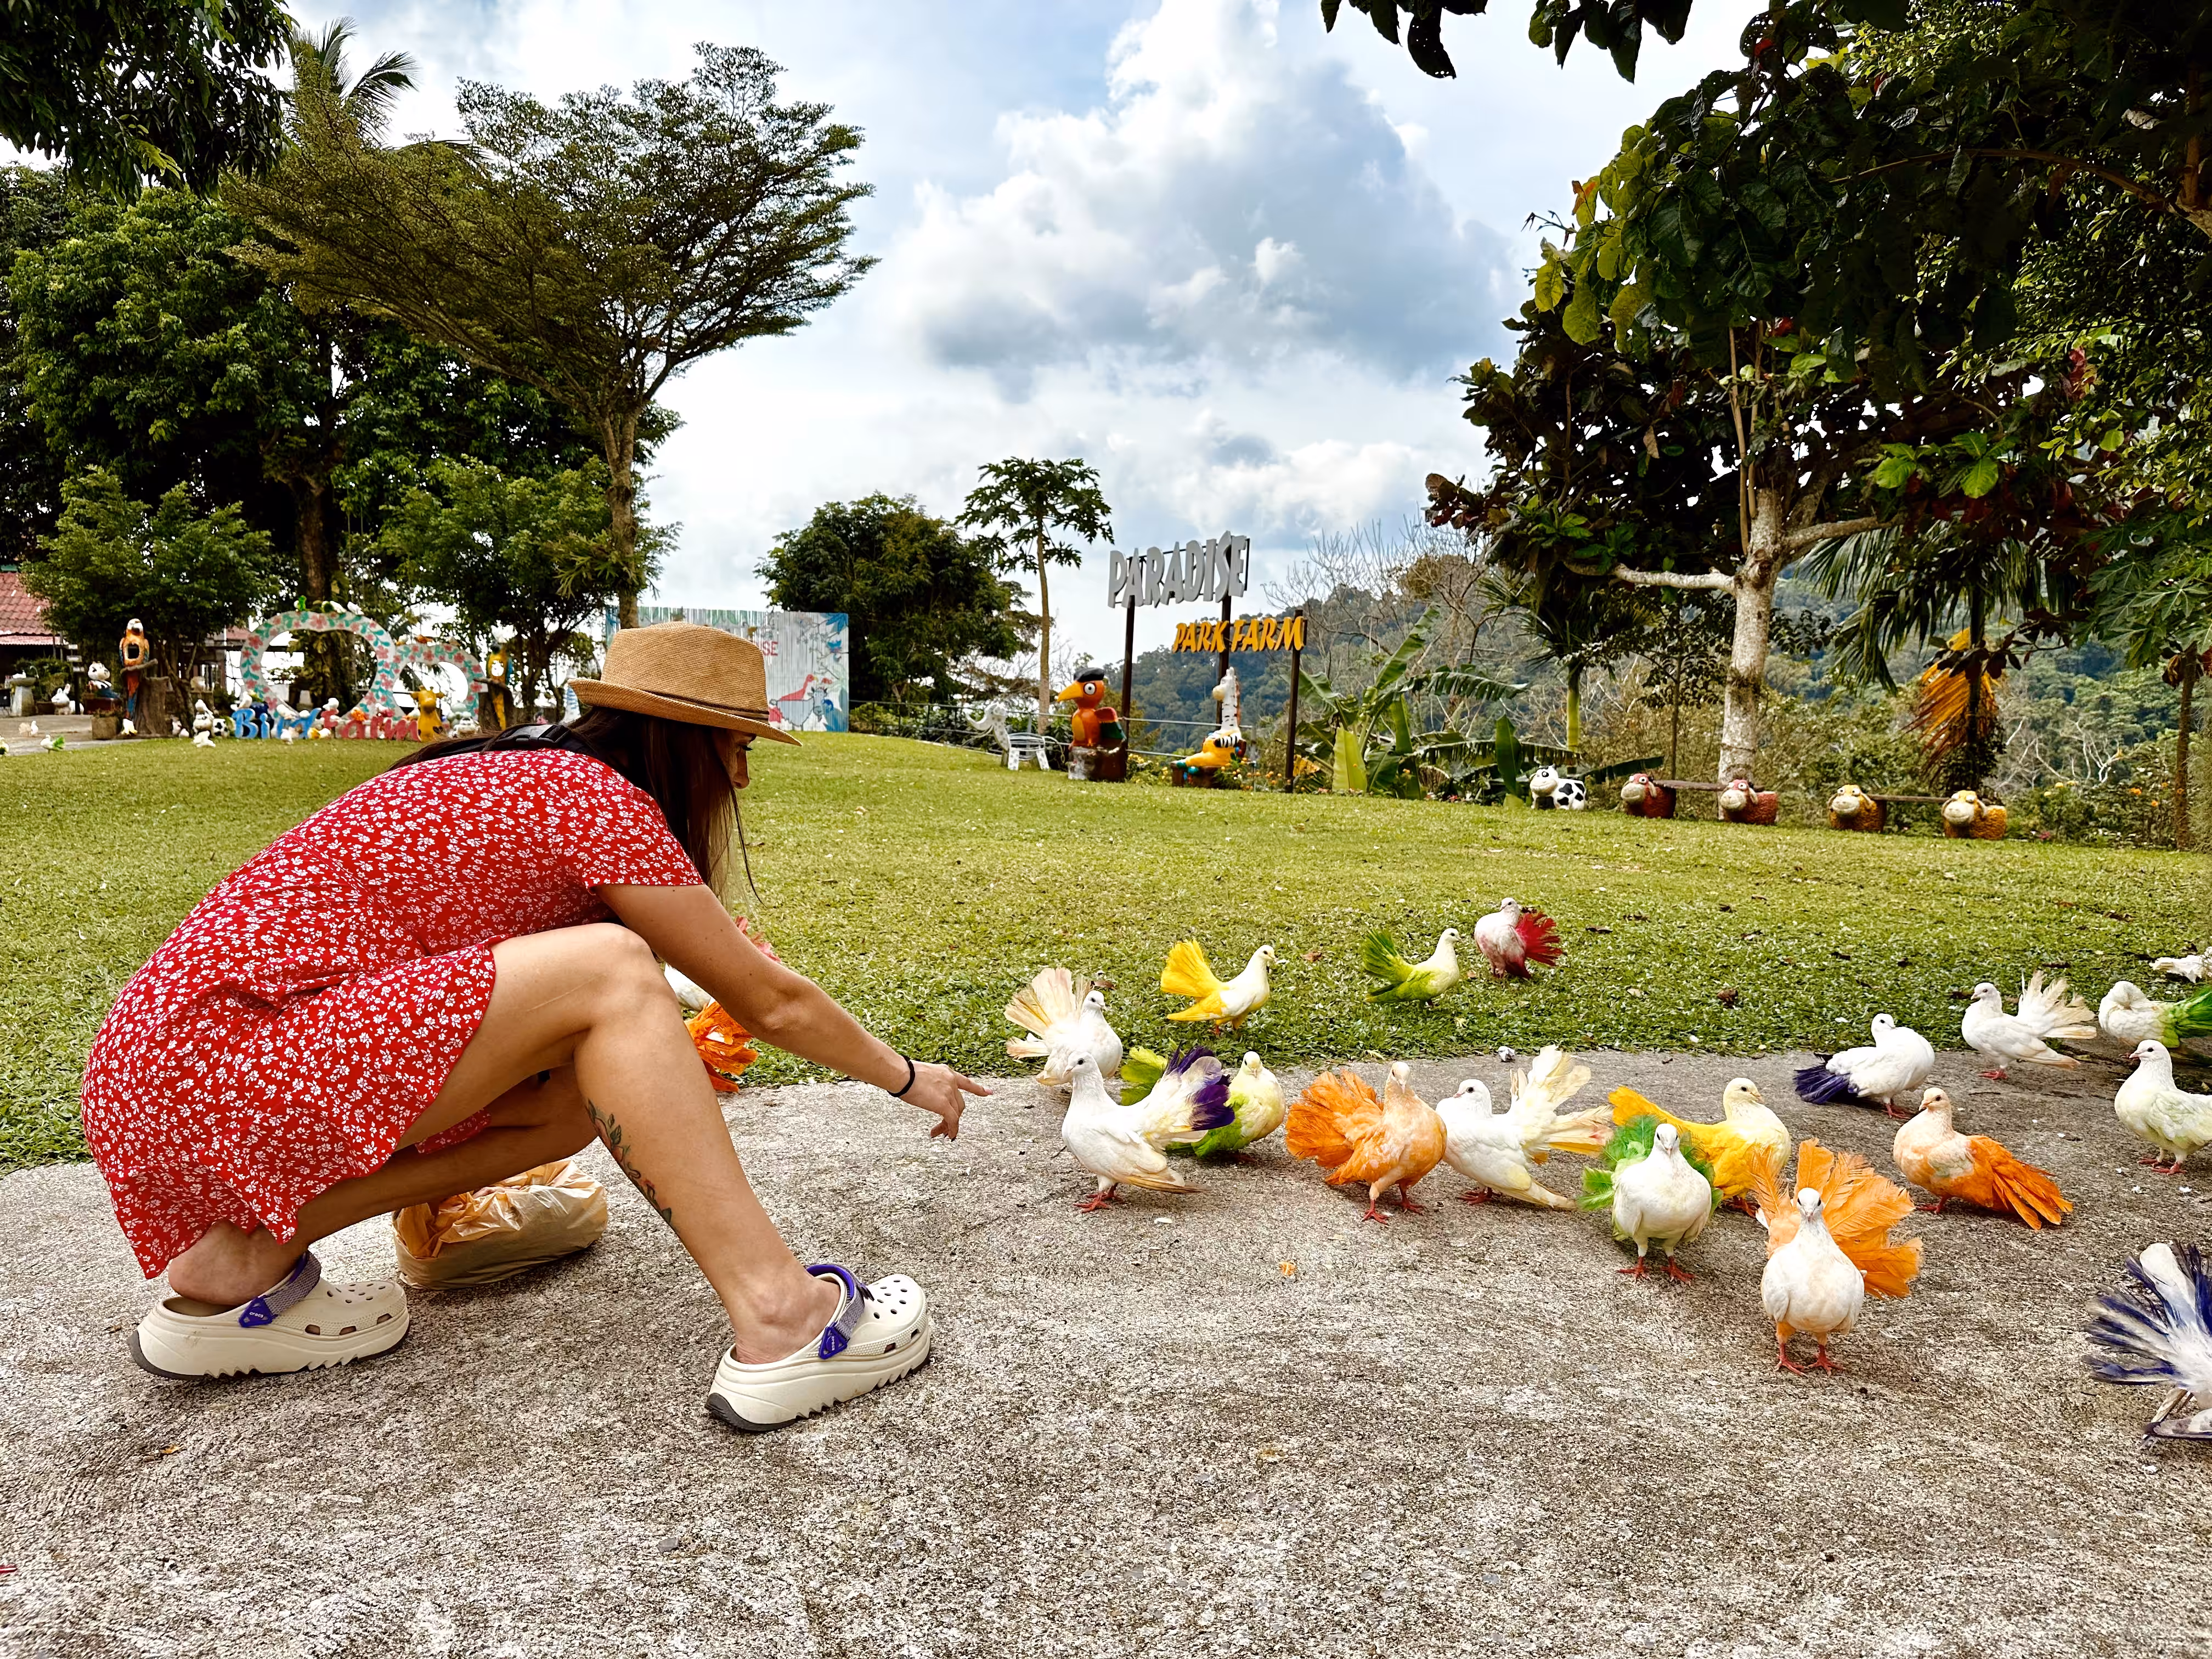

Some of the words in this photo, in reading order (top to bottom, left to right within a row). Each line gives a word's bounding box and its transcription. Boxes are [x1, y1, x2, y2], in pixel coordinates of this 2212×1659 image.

[1108, 531, 1247, 608] PARADISE
[1173, 620, 1229, 653] PARK
[1231, 616, 1306, 653] FARM
